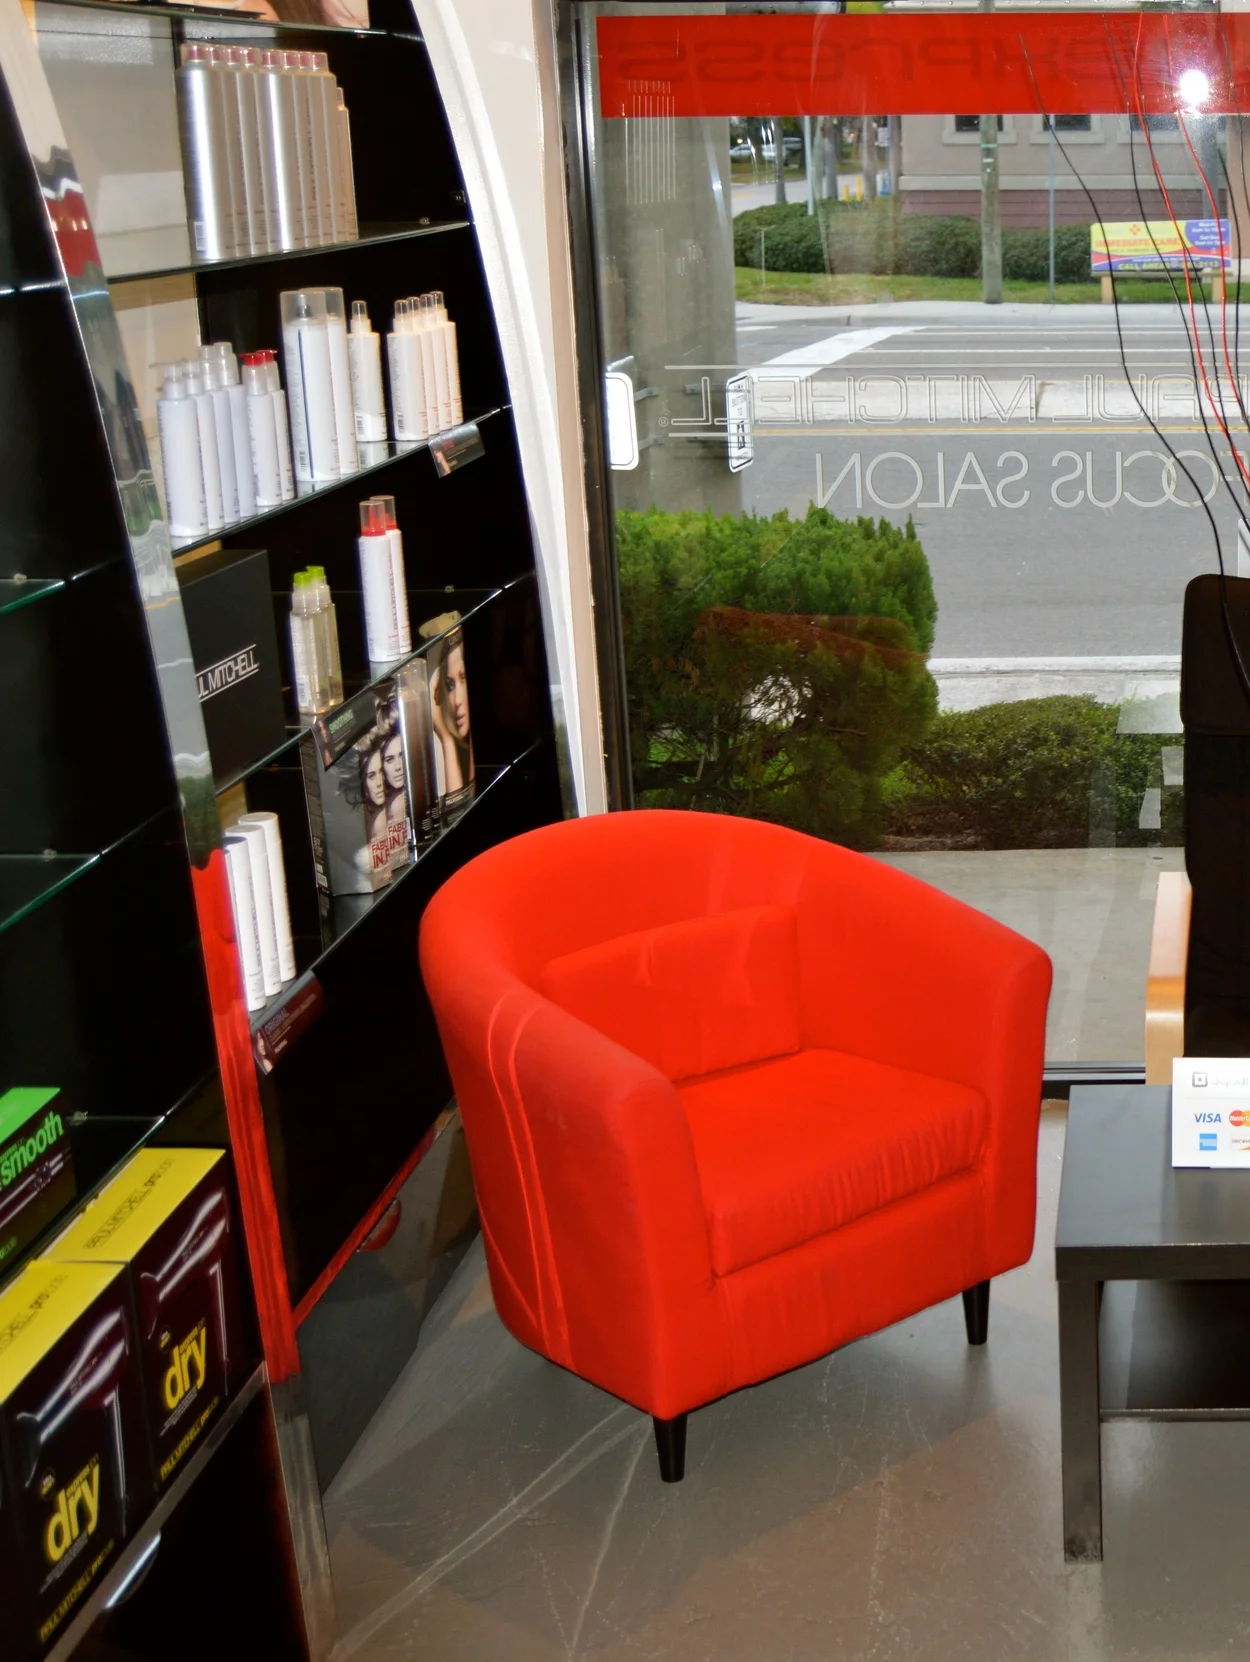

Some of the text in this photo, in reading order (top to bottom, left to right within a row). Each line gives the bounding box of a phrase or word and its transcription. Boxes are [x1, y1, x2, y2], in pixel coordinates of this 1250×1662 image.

[208, 650, 260, 692] MITCHELL
[1, 1111, 64, 1187] smooth
[1194, 1113, 1222, 1123] VISA
[165, 1327, 206, 1409] dry
[47, 1463, 99, 1562] dry
